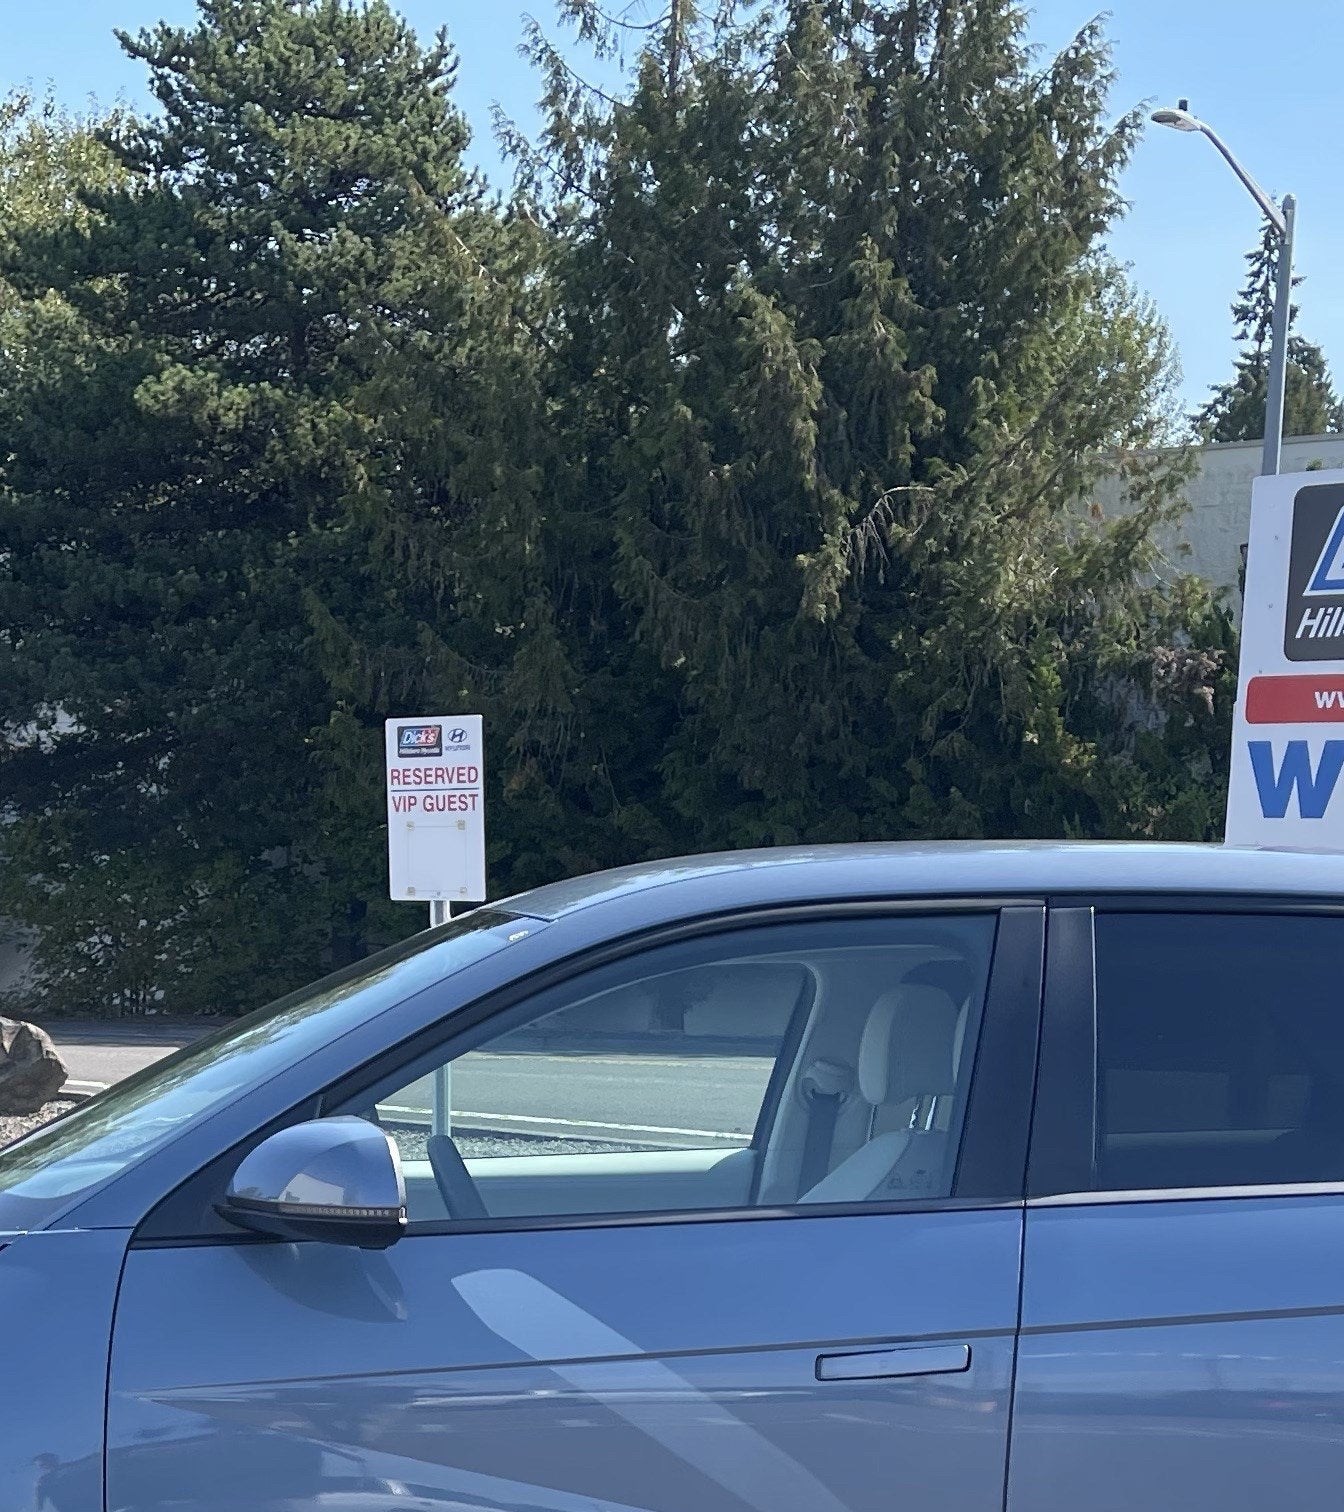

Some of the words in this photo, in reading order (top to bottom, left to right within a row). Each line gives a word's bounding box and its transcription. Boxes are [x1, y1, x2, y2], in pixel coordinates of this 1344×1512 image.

[390, 766, 479, 786] RESERVED
[391, 795, 417, 812] VIP
[422, 793, 479, 812] GUEST
